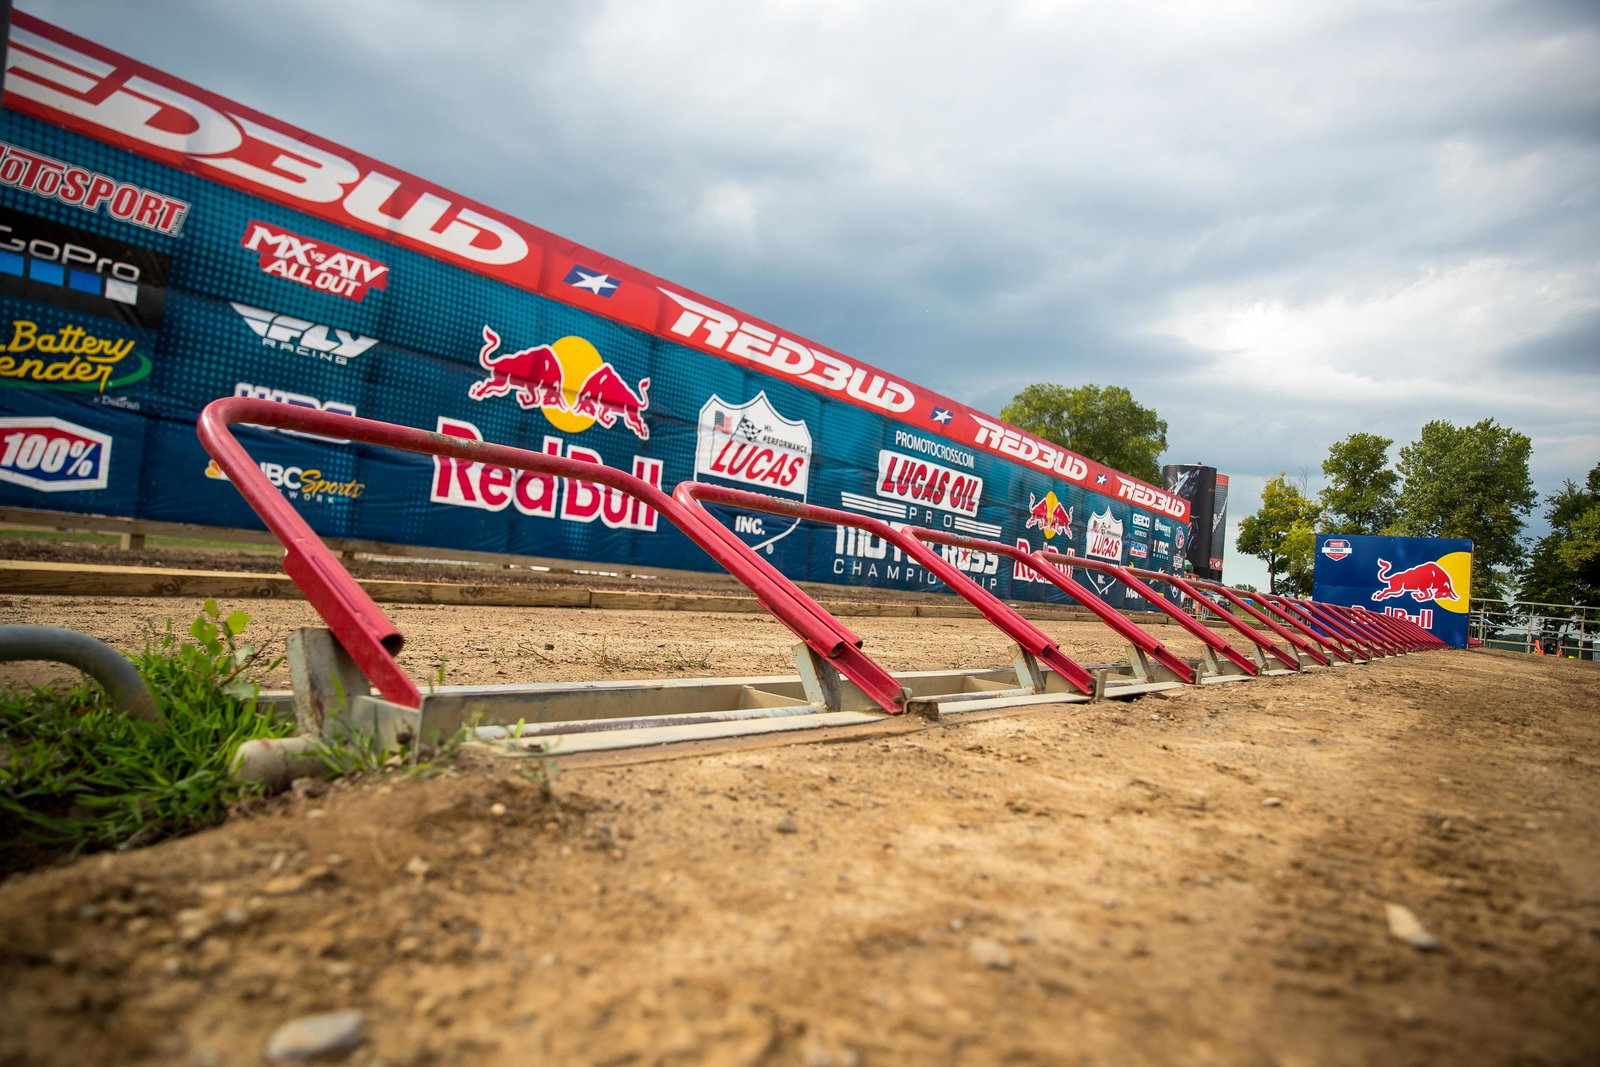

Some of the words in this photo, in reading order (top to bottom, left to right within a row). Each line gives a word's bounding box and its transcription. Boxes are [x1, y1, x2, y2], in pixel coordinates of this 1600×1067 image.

[4, 24, 528, 265] EDBUD
[0, 144, 187, 234] OTOSPORT
[244, 225, 318, 267] MX
[315, 252, 390, 283] ATV
[263, 259, 313, 285] ALL
[315, 272, 362, 297] OUT
[8, 320, 136, 363] Battery
[230, 301, 380, 358] FLY
[656, 286, 916, 414] REDBUD
[262, 337, 348, 366] RACING
[0, 356, 114, 393] ender
[1, 432, 95, 478] 100%
[710, 440, 804, 487] LUCAS
[763, 436, 808, 454] PERFORMANCE
[968, 413, 1089, 481] REDBUD
[300, 469, 366, 499] Sports
[881, 456, 950, 505] LUCAS
[949, 475, 979, 512] OIL
[1116, 475, 1186, 517] REDBUD
[735, 515, 766, 536] INC.
[908, 506, 953, 528] PRO
[1091, 535, 1120, 558] LUCAS
